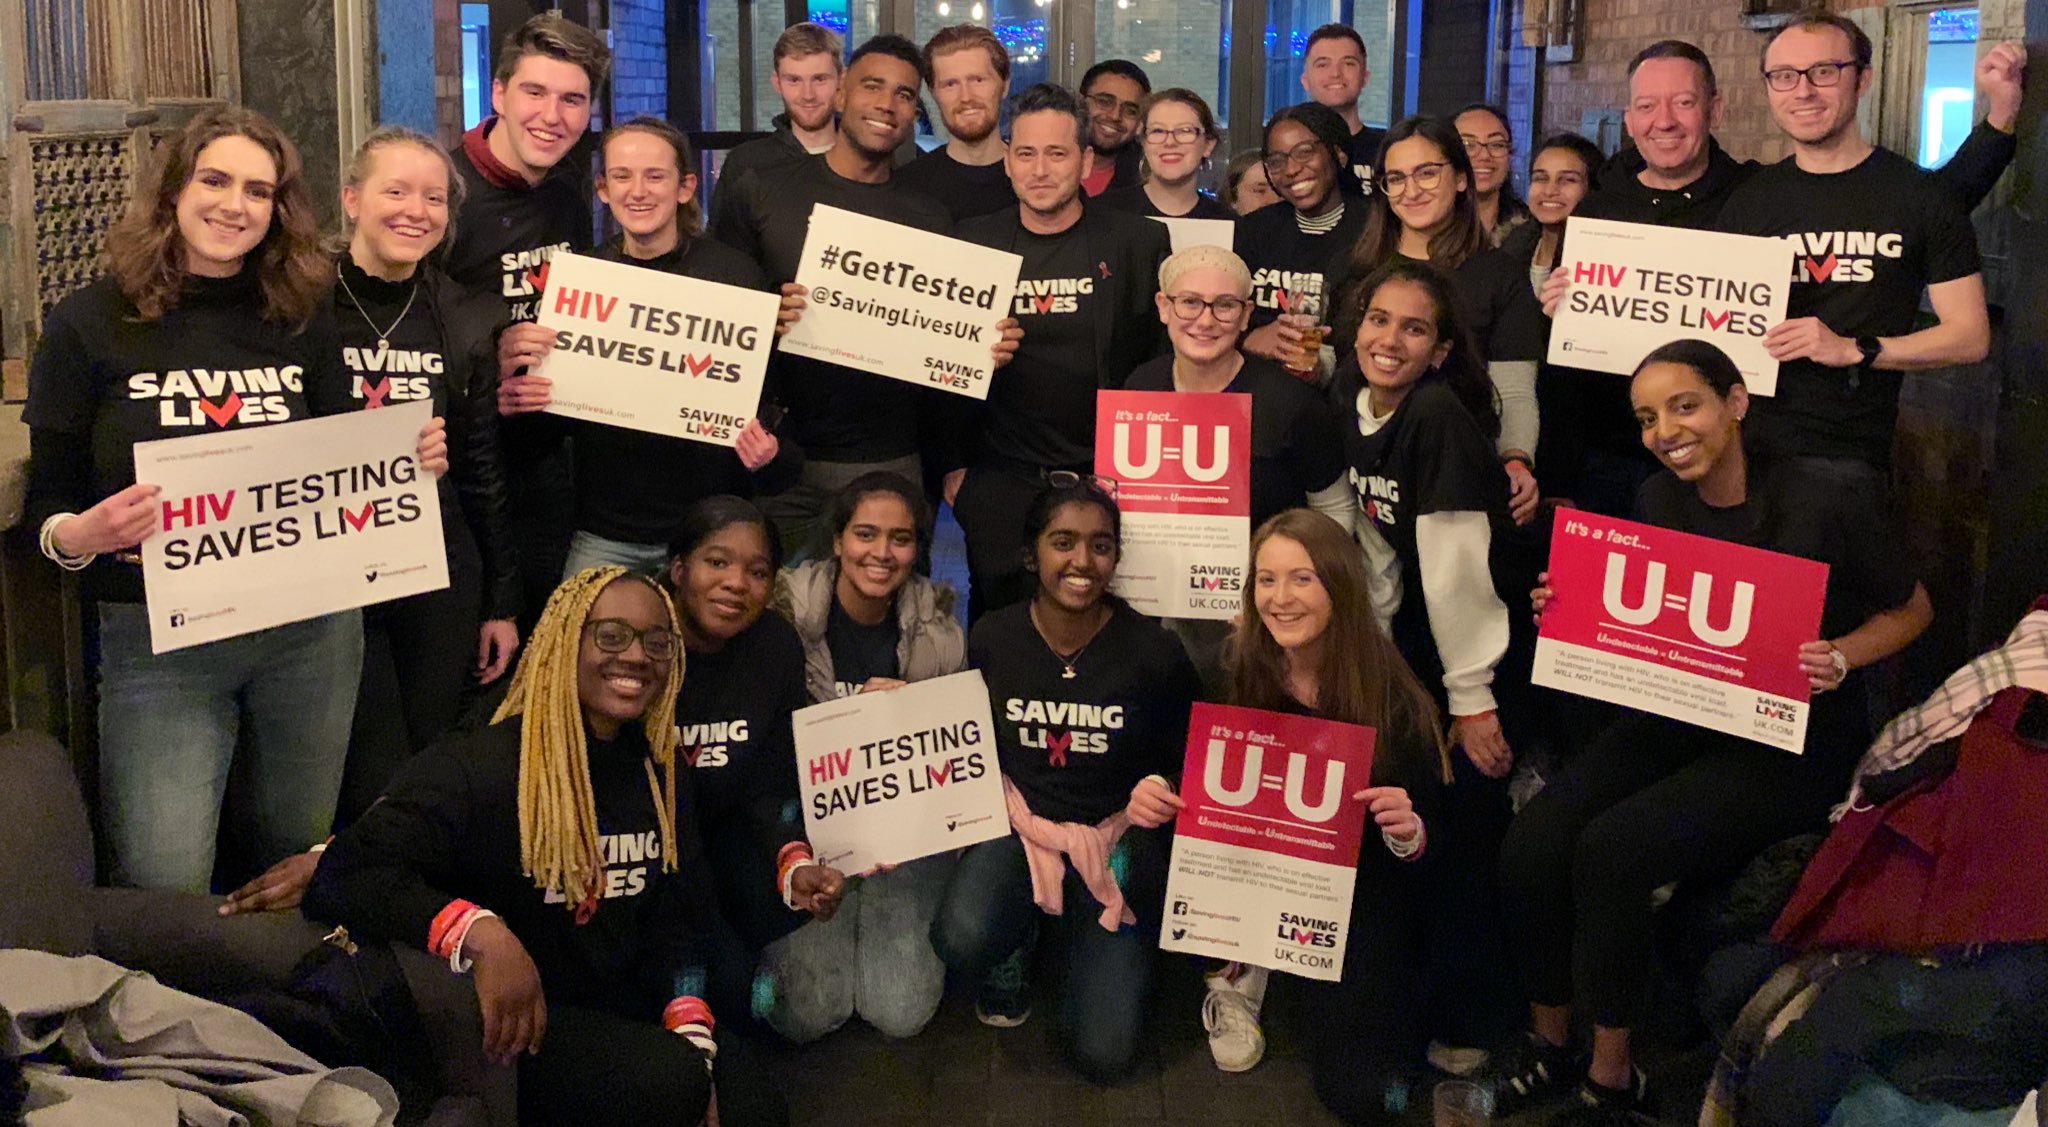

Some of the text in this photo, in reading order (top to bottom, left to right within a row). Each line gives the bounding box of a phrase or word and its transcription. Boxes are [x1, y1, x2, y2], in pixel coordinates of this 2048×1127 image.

[1786, 231, 1903, 258] AVING
[503, 261, 550, 297] LIV
[820, 244, 998, 310] #GetTested
[1791, 253, 1874, 283] IVES
[1015, 278, 1093, 296] AVING
[1574, 261, 1772, 307] HIV TESTING
[554, 286, 619, 323] HIV
[629, 303, 758, 351] TESTING
[811, 285, 984, 343] @SavingLivesUK
[1015, 293, 1078, 315] LIVES
[1569, 291, 1767, 337] SAVES LIVES
[343, 347, 444, 374] AVING
[554, 331, 741, 384] SAVES LIVES
[787, 338, 884, 367] www.savinglivesuk.com
[128, 365, 304, 400] SAVING
[924, 357, 984, 380] SAVING
[929, 371, 969, 389] LIVES
[350, 376, 431, 402] IVES
[160, 391, 290, 427] LIVES
[552, 398, 635, 420] savinglivesuk.com
[679, 407, 745, 429] SAVING
[1115, 410, 1133, 421] It's
[1136, 413, 1145, 421] a
[686, 422, 730, 440] LIVES
[162, 456, 417, 531] HIV TESTING
[1349, 466, 1400, 503] AVING
[1357, 493, 1396, 525] IVES
[164, 493, 421, 571] SAVES LIVES
[1565, 520, 1650, 550] It's a fact...
[1190, 564, 1240, 576] SAVING
[1190, 576, 1240, 591] LIVES
[1189, 597, 1240, 610] UK.COM
[1603, 551, 1755, 647] U=U
[1596, 632, 1658, 656] Undetectable
[1668, 650, 1745, 678] Untransmittable
[1006, 698, 1124, 729] SAVING
[1756, 704, 1795, 722] LIVES
[1757, 696, 1797, 713] SAVING
[675, 720, 749, 746] VING
[1019, 727, 1109, 756] LIVES
[1211, 725, 1286, 748] It's a fact...
[1753, 719, 1794, 736] UK.COM
[681, 744, 729, 768] VES
[809, 719, 982, 786] HIV TESTING
[813, 753, 986, 820] SAVES LIVES
[1203, 738, 1346, 823] U=U
[598, 830, 660, 864] ING
[544, 867, 647, 904] LES
[1277, 924, 1336, 948] LIVES
[1279, 912, 1338, 932] SAVING
[1274, 948, 1333, 969] UK.COM
